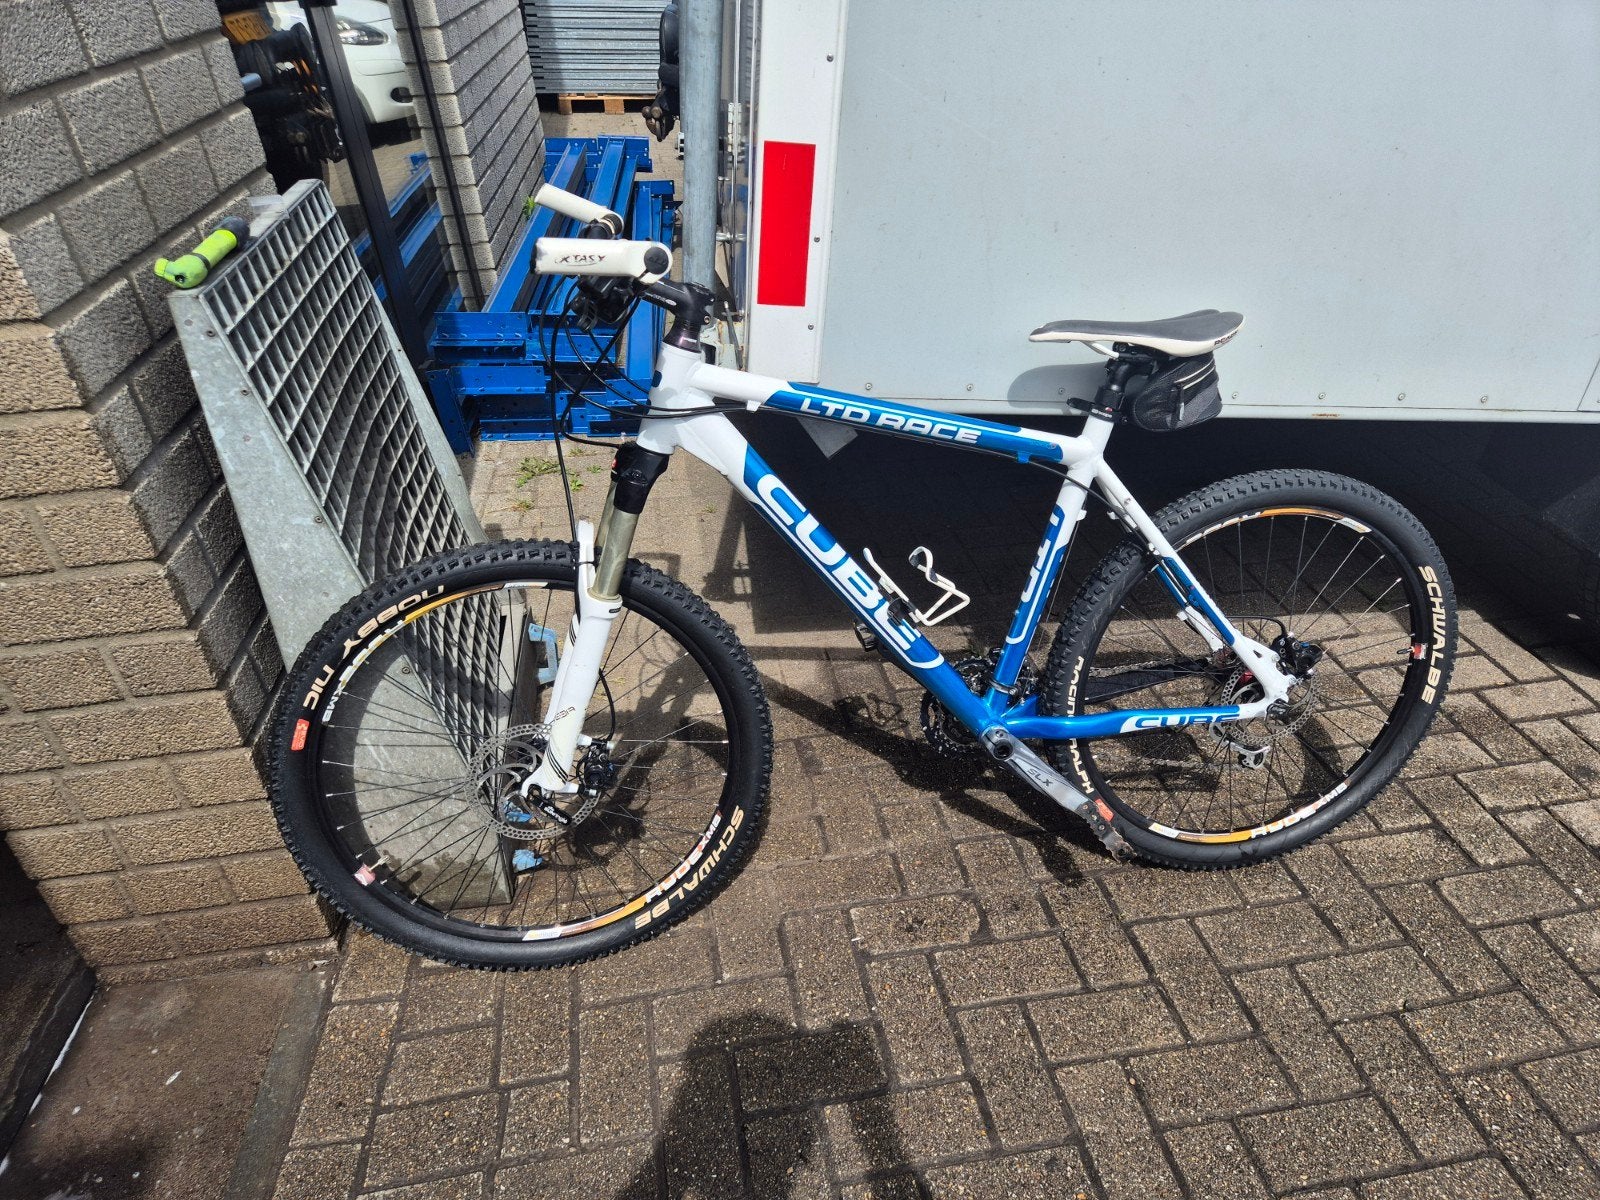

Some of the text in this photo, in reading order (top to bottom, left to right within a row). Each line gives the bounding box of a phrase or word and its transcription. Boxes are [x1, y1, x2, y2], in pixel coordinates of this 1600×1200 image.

[800, 397, 982, 444] LTD RACE
[757, 474, 921, 651] CUBE
[302, 584, 445, 711] NOBBY NIC
[1418, 565, 1446, 705] SCHWALBE
[1027, 768, 1054, 787] SLX
[1066, 655, 1095, 794] RACIN RALPH
[634, 804, 745, 930] SCHWALBE
